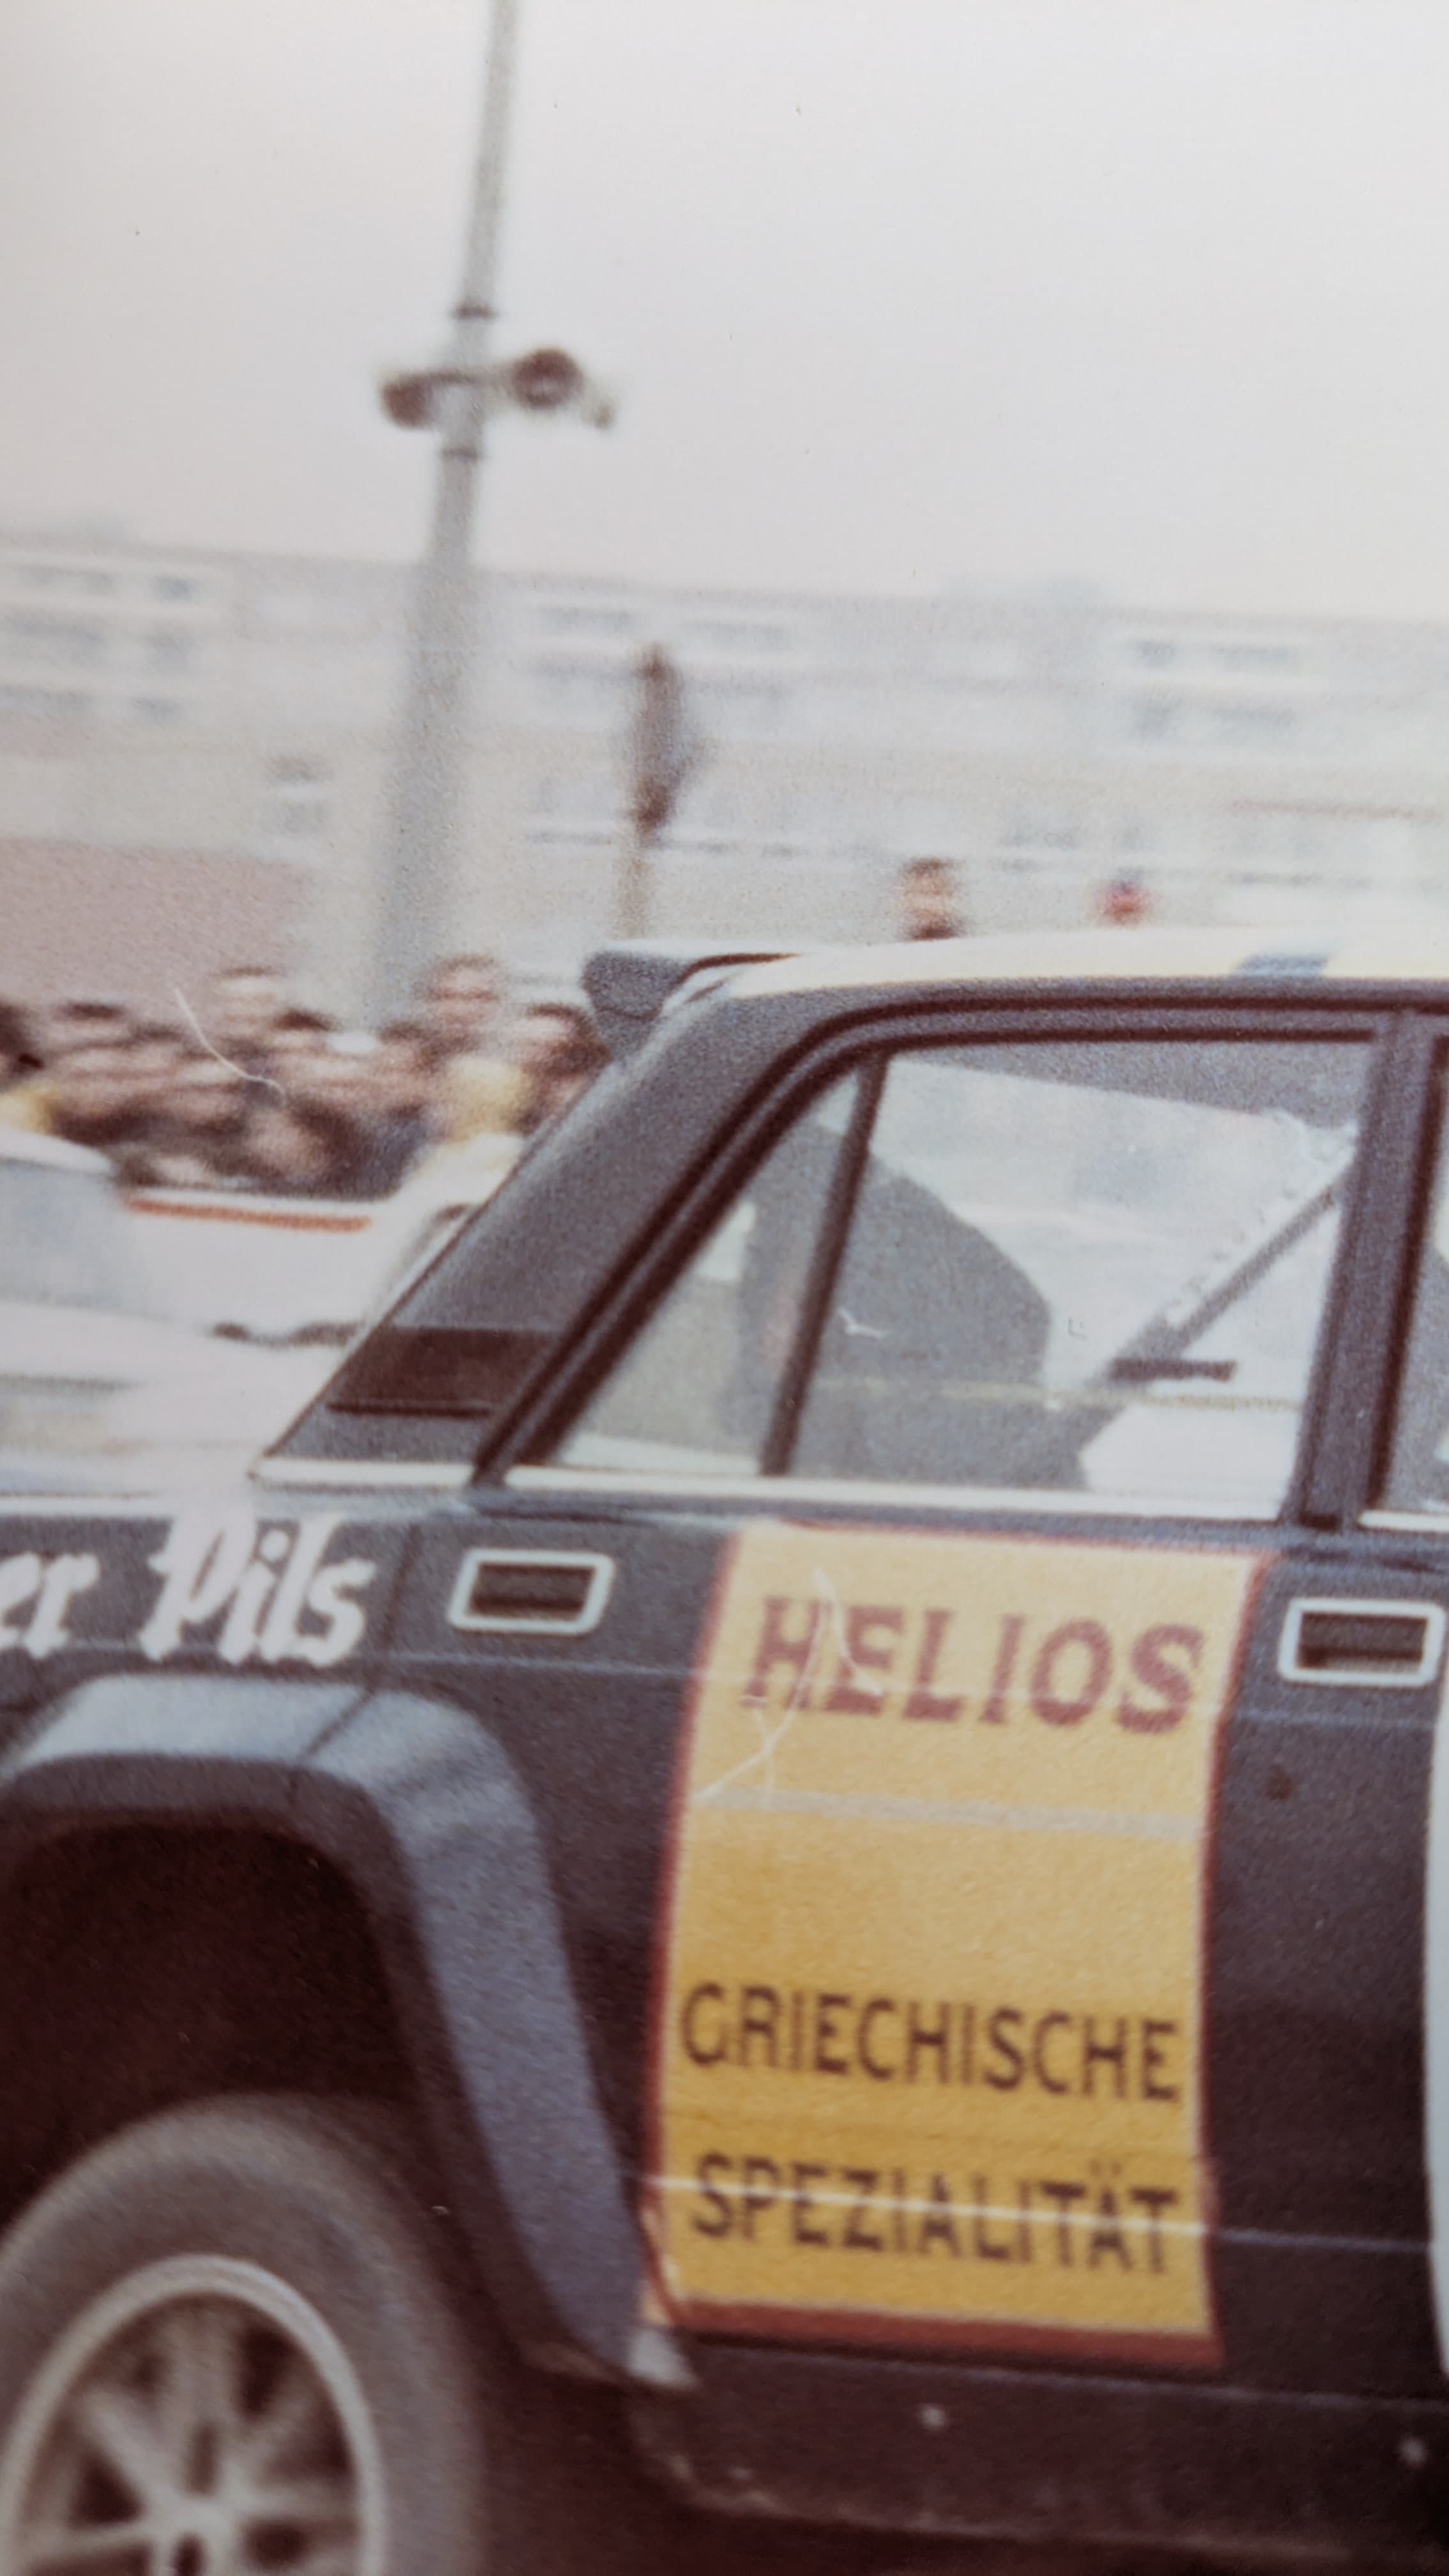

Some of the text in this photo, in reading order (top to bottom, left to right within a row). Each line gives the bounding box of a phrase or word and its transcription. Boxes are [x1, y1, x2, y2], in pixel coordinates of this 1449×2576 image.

[139, 1509, 376, 1667] Pils
[739, 1595, 1205, 1735] HELIOS
[680, 1981, 1178, 2103] GRIECHISCHE
[692, 2153, 1177, 2274] SPEZIALITÄT
